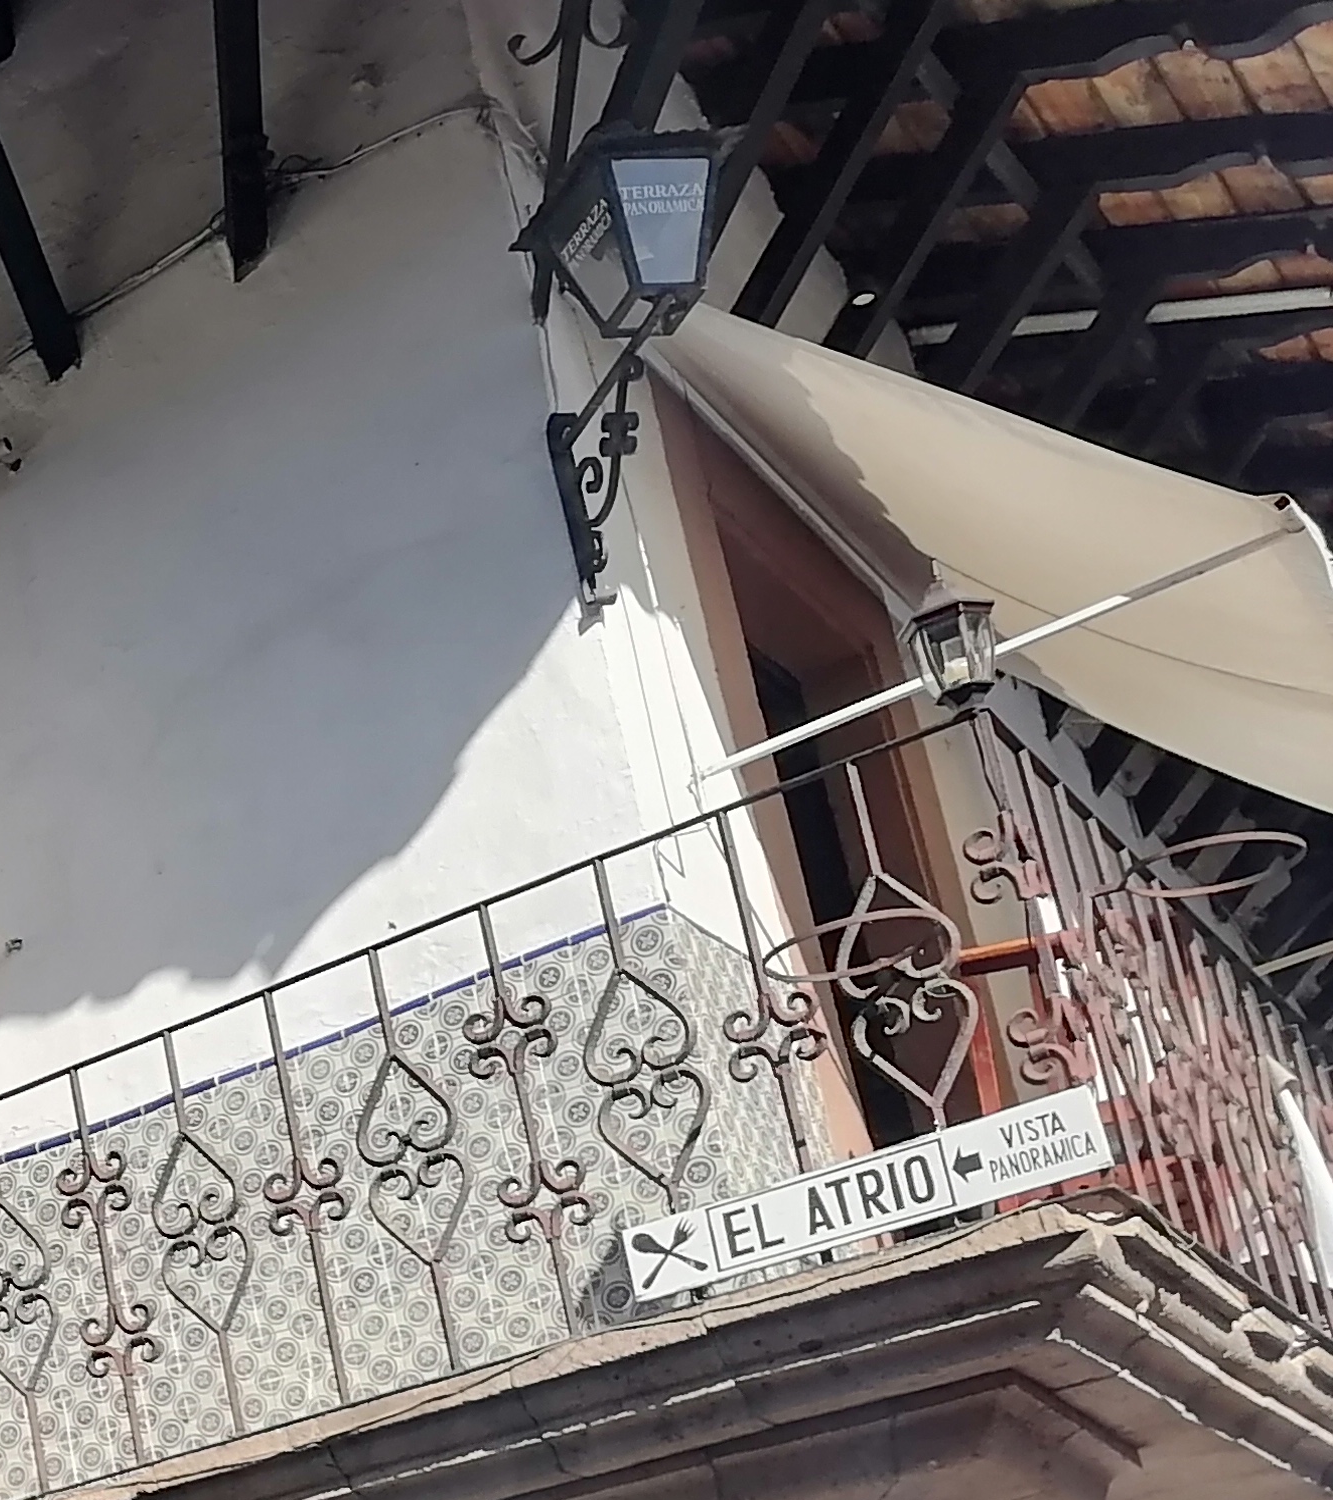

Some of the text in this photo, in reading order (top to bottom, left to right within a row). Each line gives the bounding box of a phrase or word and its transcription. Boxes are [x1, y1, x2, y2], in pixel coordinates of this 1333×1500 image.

[619, 182, 705, 200] TERRAZA
[560, 198, 609, 261] TERRAZA
[998, 1110, 1067, 1149] VISTA
[988, 1130, 1098, 1184] PANORAMICA
[722, 1154, 937, 1259] EL ATRIO
